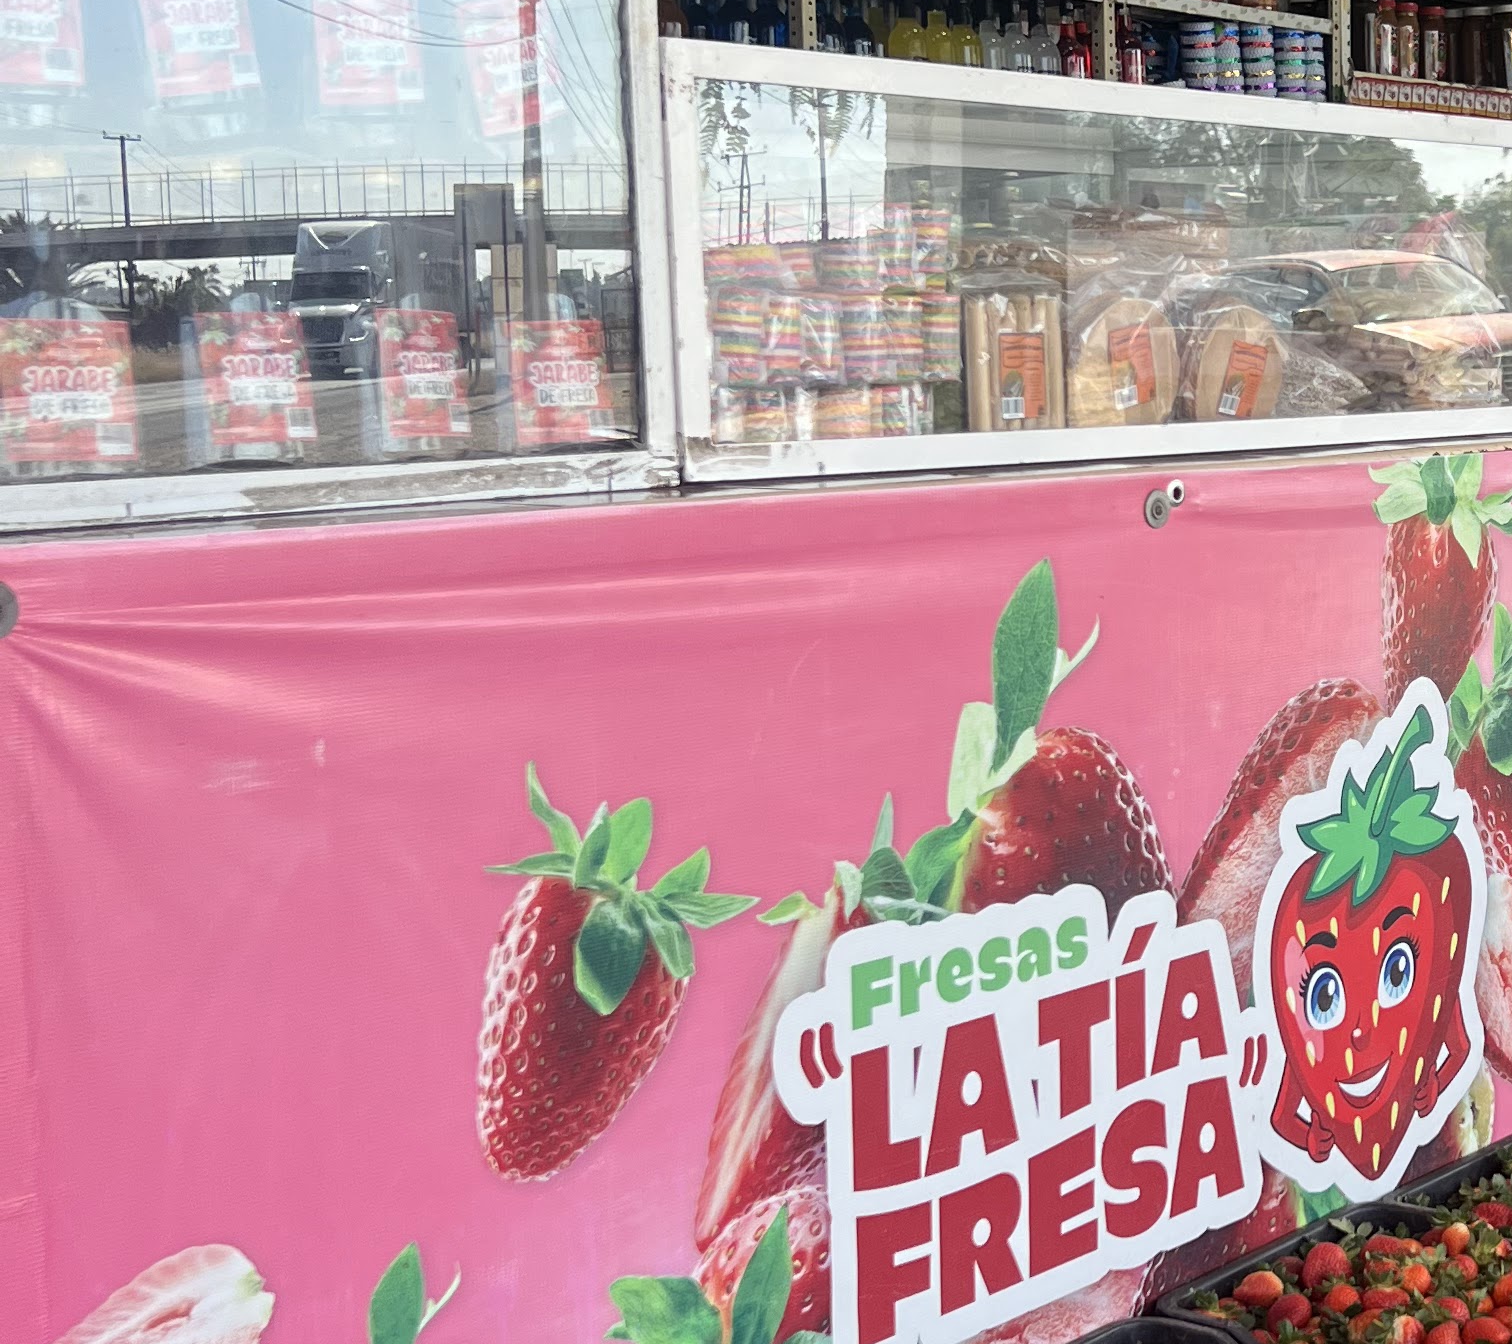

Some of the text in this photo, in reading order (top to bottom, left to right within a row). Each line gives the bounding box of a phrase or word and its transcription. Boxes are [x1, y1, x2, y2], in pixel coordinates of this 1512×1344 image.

[531, 363, 598, 385] JARABE
[539, 388, 557, 404] DE
[851, 916, 1089, 1031] Fresas
[1037, 925, 1228, 1120] TÍA
